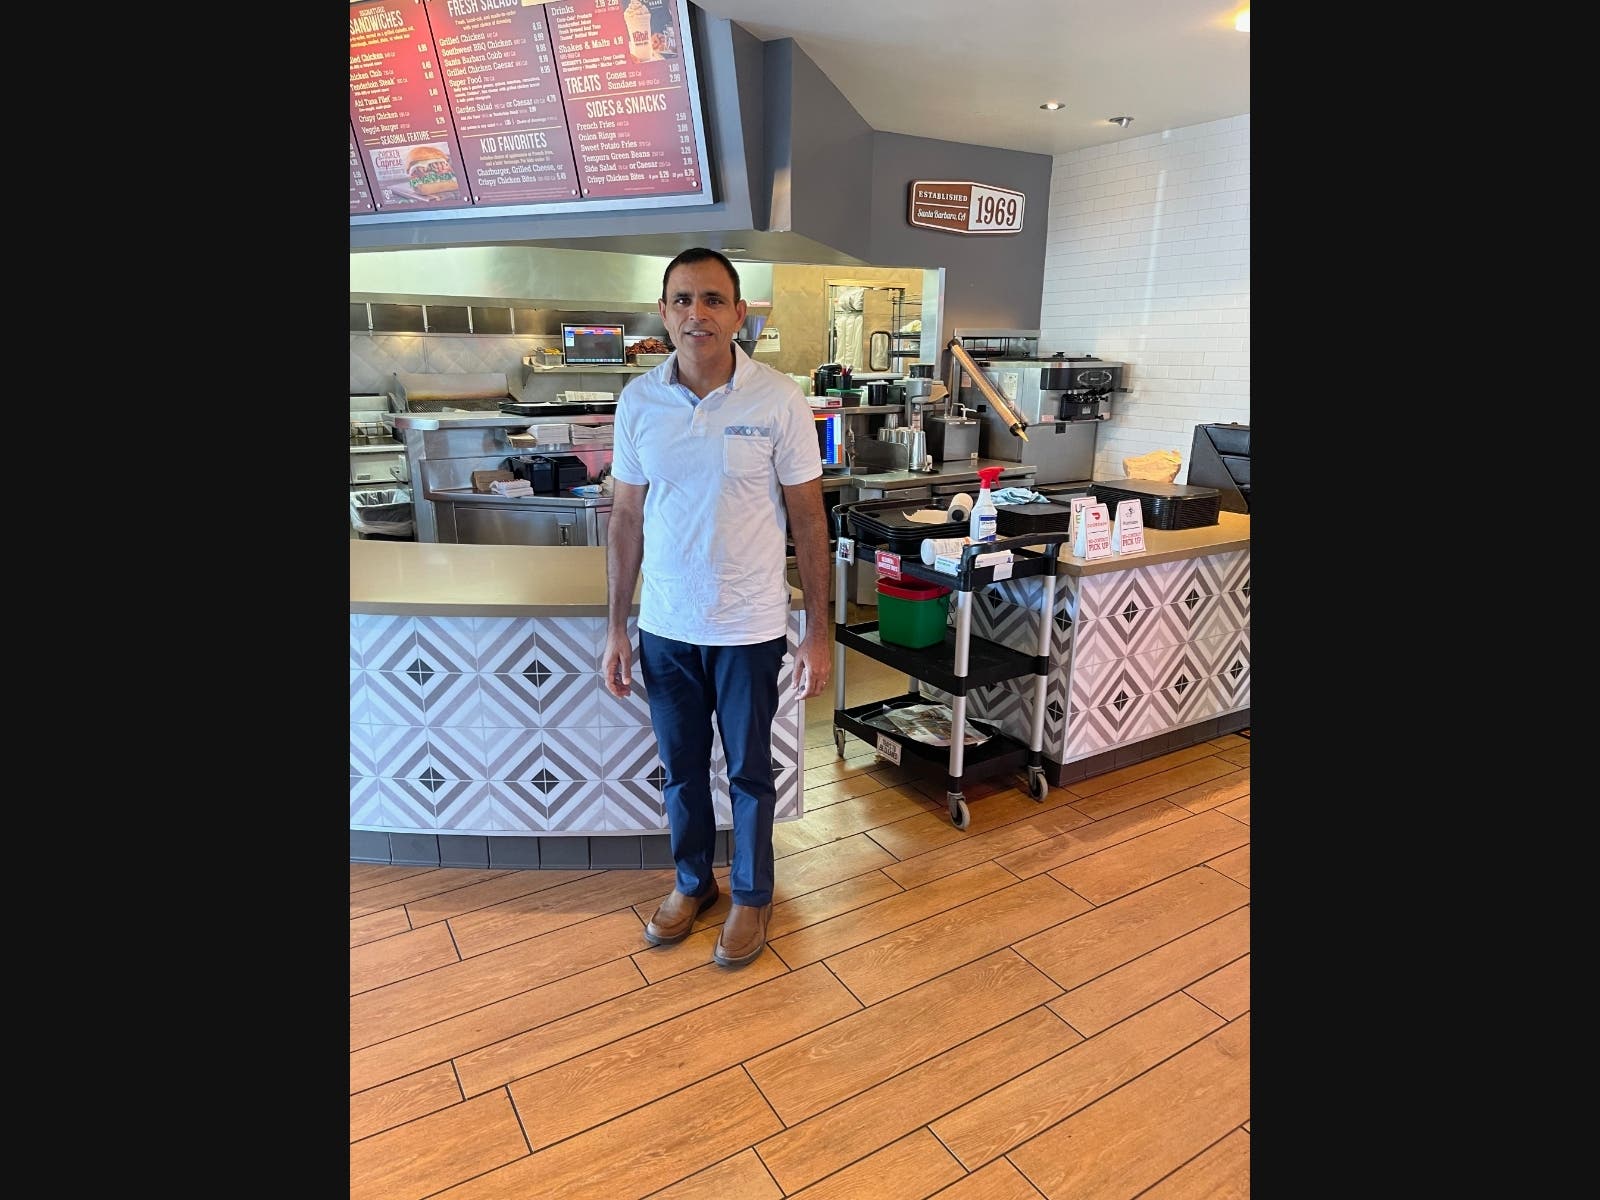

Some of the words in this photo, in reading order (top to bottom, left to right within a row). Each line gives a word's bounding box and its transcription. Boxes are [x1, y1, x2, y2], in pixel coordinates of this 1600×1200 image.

[448, 0, 478, 17] FRESH
[551, 6, 574, 16] Drinks
[350, 10, 404, 34] SANDWICHES
[439, 37, 460, 47] Grilled
[460, 33, 485, 43] Chicken
[559, 44, 583, 54] Shakes
[584, 42, 591, 50] &
[592, 38, 610, 48] Malts
[442, 46, 472, 57] Southwest
[473, 43, 486, 51] BBQ
[487, 39, 513, 49] Chicken
[350, 56, 361, 64] lled
[444, 58, 461, 67] Santa
[461, 55, 486, 64] Barbara
[486, 51, 503, 60] Cobb
[446, 66, 467, 77] Grilled
[467, 65, 492, 74] Chicken
[493, 61, 514, 70] Caesar
[350, 72, 369, 80] hicken
[449, 79, 466, 88] Super
[467, 75, 482, 84] Food
[564, 74, 602, 94] TREATS
[606, 71, 627, 81] Cones
[608, 80, 636, 90] Sundaes
[476, 103, 493, 112] Salad
[513, 99, 533, 107] Caesar
[586, 99, 616, 118] SIDES
[616, 101, 624, 114] &
[624, 93, 667, 114] SNACKS
[359, 115, 376, 123] Crispy
[376, 112, 398, 120] Chicken
[362, 126, 380, 135] Veggie
[380, 124, 399, 132] Burger
[577, 122, 598, 131] French
[599, 120, 615, 129] Fries
[380, 133, 407, 145] SEASONAL
[407, 130, 430, 142] FEATURE
[480, 136, 497, 154] KID
[497, 132, 548, 152] FAVORITES
[578, 133, 597, 141] Onion
[598, 131, 616, 142] Rings
[580, 143, 600, 152] Sweet
[601, 141, 620, 150] Potato
[621, 140, 638, 148] Fries
[582, 154, 610, 163] Tempura
[611, 152, 630, 160] Green
[631, 150, 651, 159] Beans
[477, 167, 511, 177] Charburger,
[511, 165, 532, 174] Grilled
[532, 163, 556, 172] Cheese,
[584, 164, 599, 173] Side
[599, 163, 617, 172] Salad
[636, 160, 658, 169] Caesar
[478, 178, 496, 187] Crispy
[497, 176, 521, 185] Chicken
[587, 175, 605, 185] Crispy
[606, 174, 630, 183] Chicken
[630, 171, 645, 180] Bites
[918, 190, 968, 202] ESTABLISHED
[918, 208, 934, 218] Santa
[934, 210, 957, 220] Barbara,
[976, 196, 1017, 226] 1969
[1089, 543, 1101, 552] PICK
[1122, 539, 1134, 547] PICK
